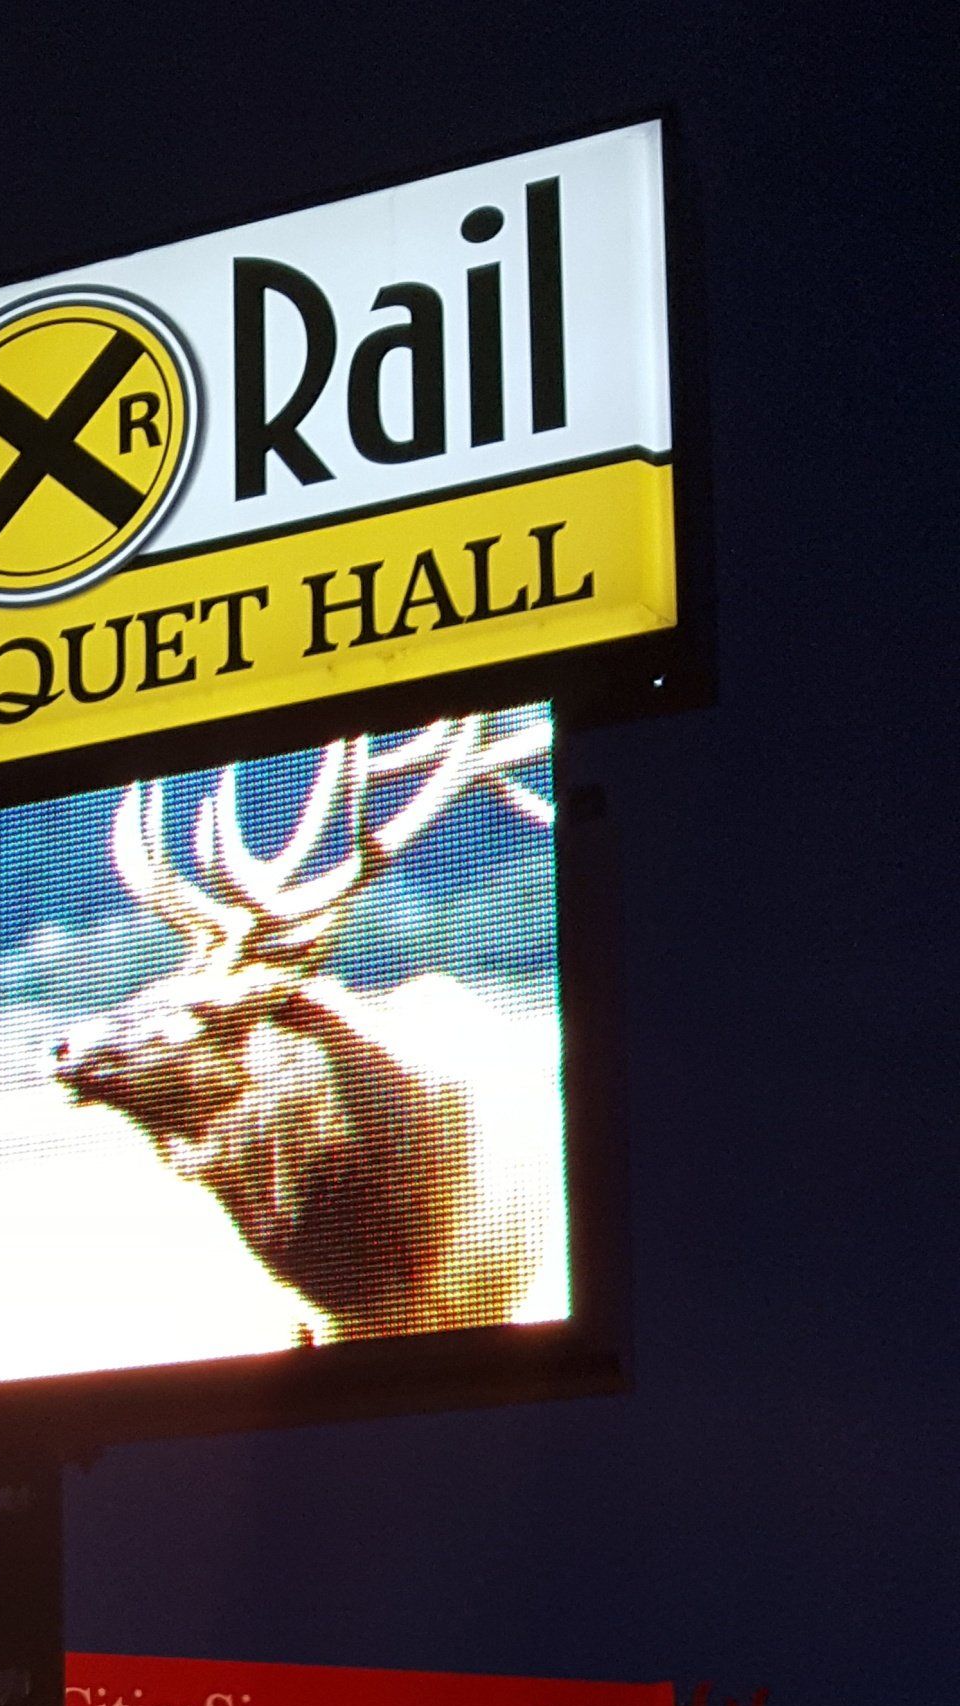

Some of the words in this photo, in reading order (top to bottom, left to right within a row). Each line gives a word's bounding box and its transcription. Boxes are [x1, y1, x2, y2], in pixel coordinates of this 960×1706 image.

[233, 176, 568, 502] Rail
[118, 391, 163, 456] R
[301, 522, 596, 659] HALL
